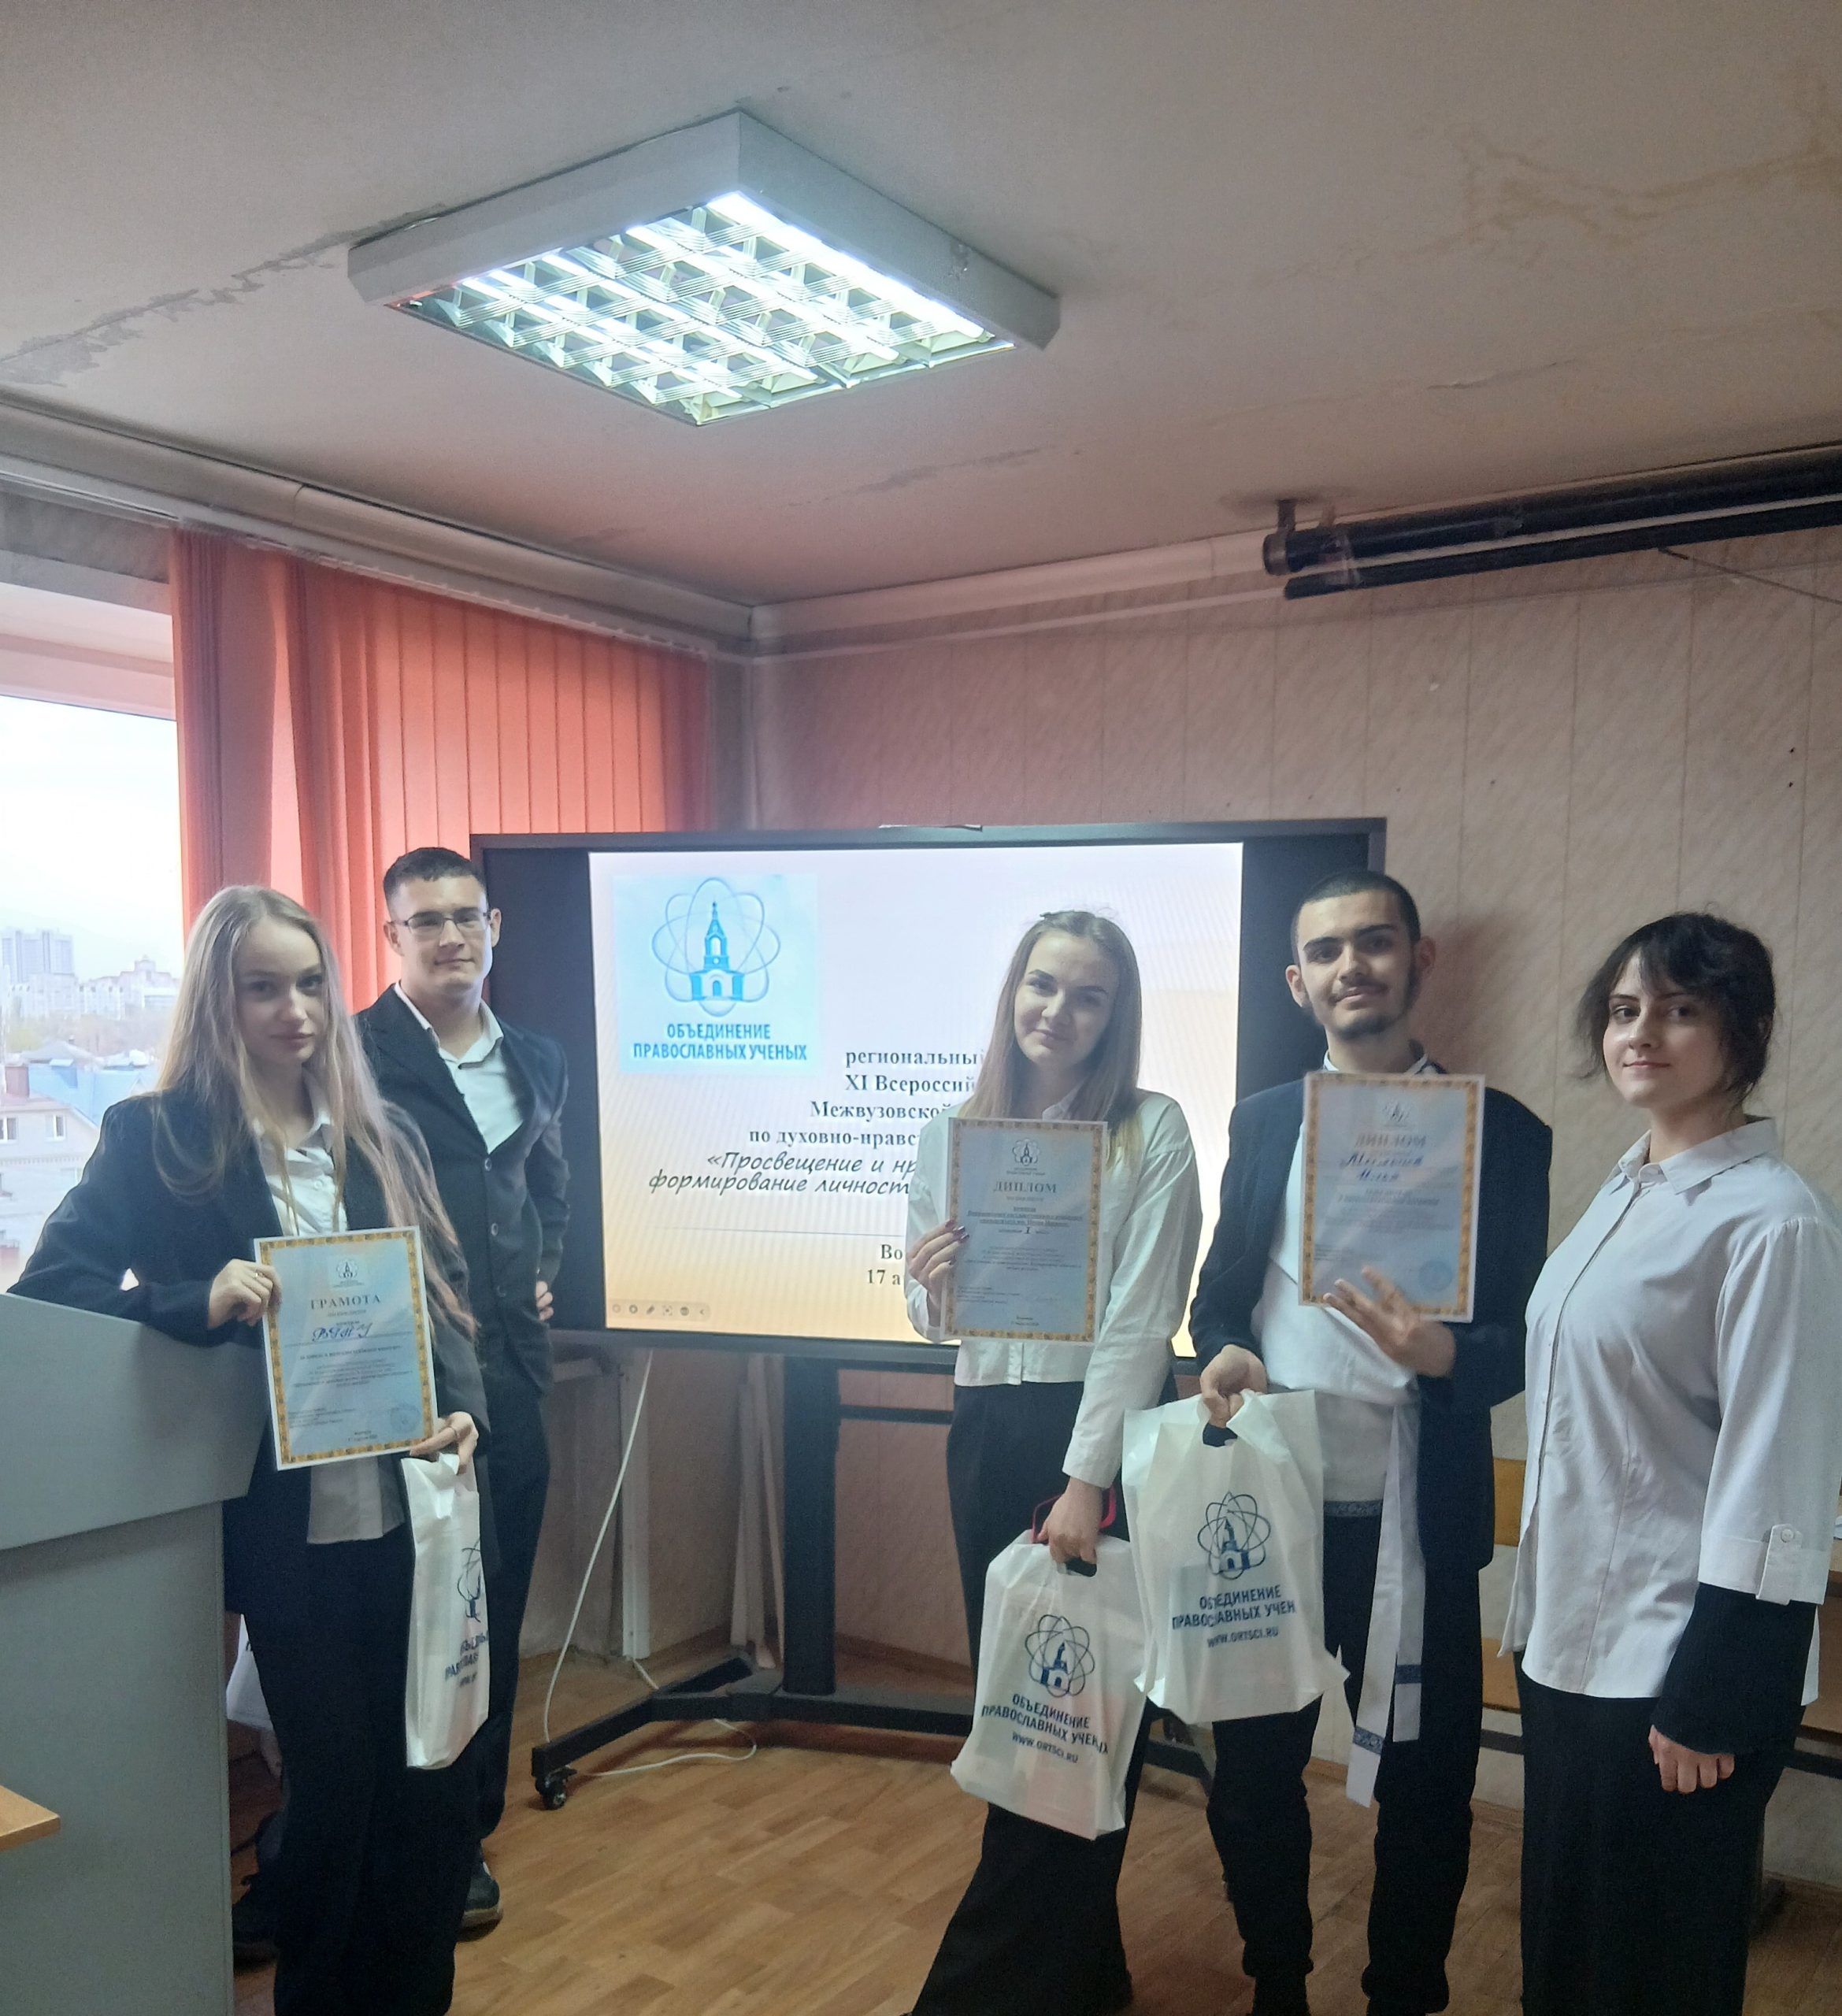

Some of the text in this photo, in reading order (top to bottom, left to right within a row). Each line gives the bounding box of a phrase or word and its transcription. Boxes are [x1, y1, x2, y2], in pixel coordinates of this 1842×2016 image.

[666, 1023, 771, 1041] ОБЪЕДИНЕНИЕ
[633, 1043, 807, 1060] ПРАВОСЛАВНЫХ УЧЕНЫХ
[845, 1074, 867, 1091] XI
[749, 1130, 920, 1149] по духовно-нравс
[708, 1151, 862, 1175] «Просвещение
[871, 1160, 884, 1173] и
[649, 1169, 807, 1195] формирование
[993, 1181, 1057, 1193] ДИПЛОМ
[867, 1269, 886, 1284] 17
[310, 1294, 380, 1310] ГРАМОТА
[1012, 1693, 1090, 1729] ОБЪЕДИНЕНИЕ
[981, 1705, 1069, 1742] ПРАВОСЛАВНЫХ
